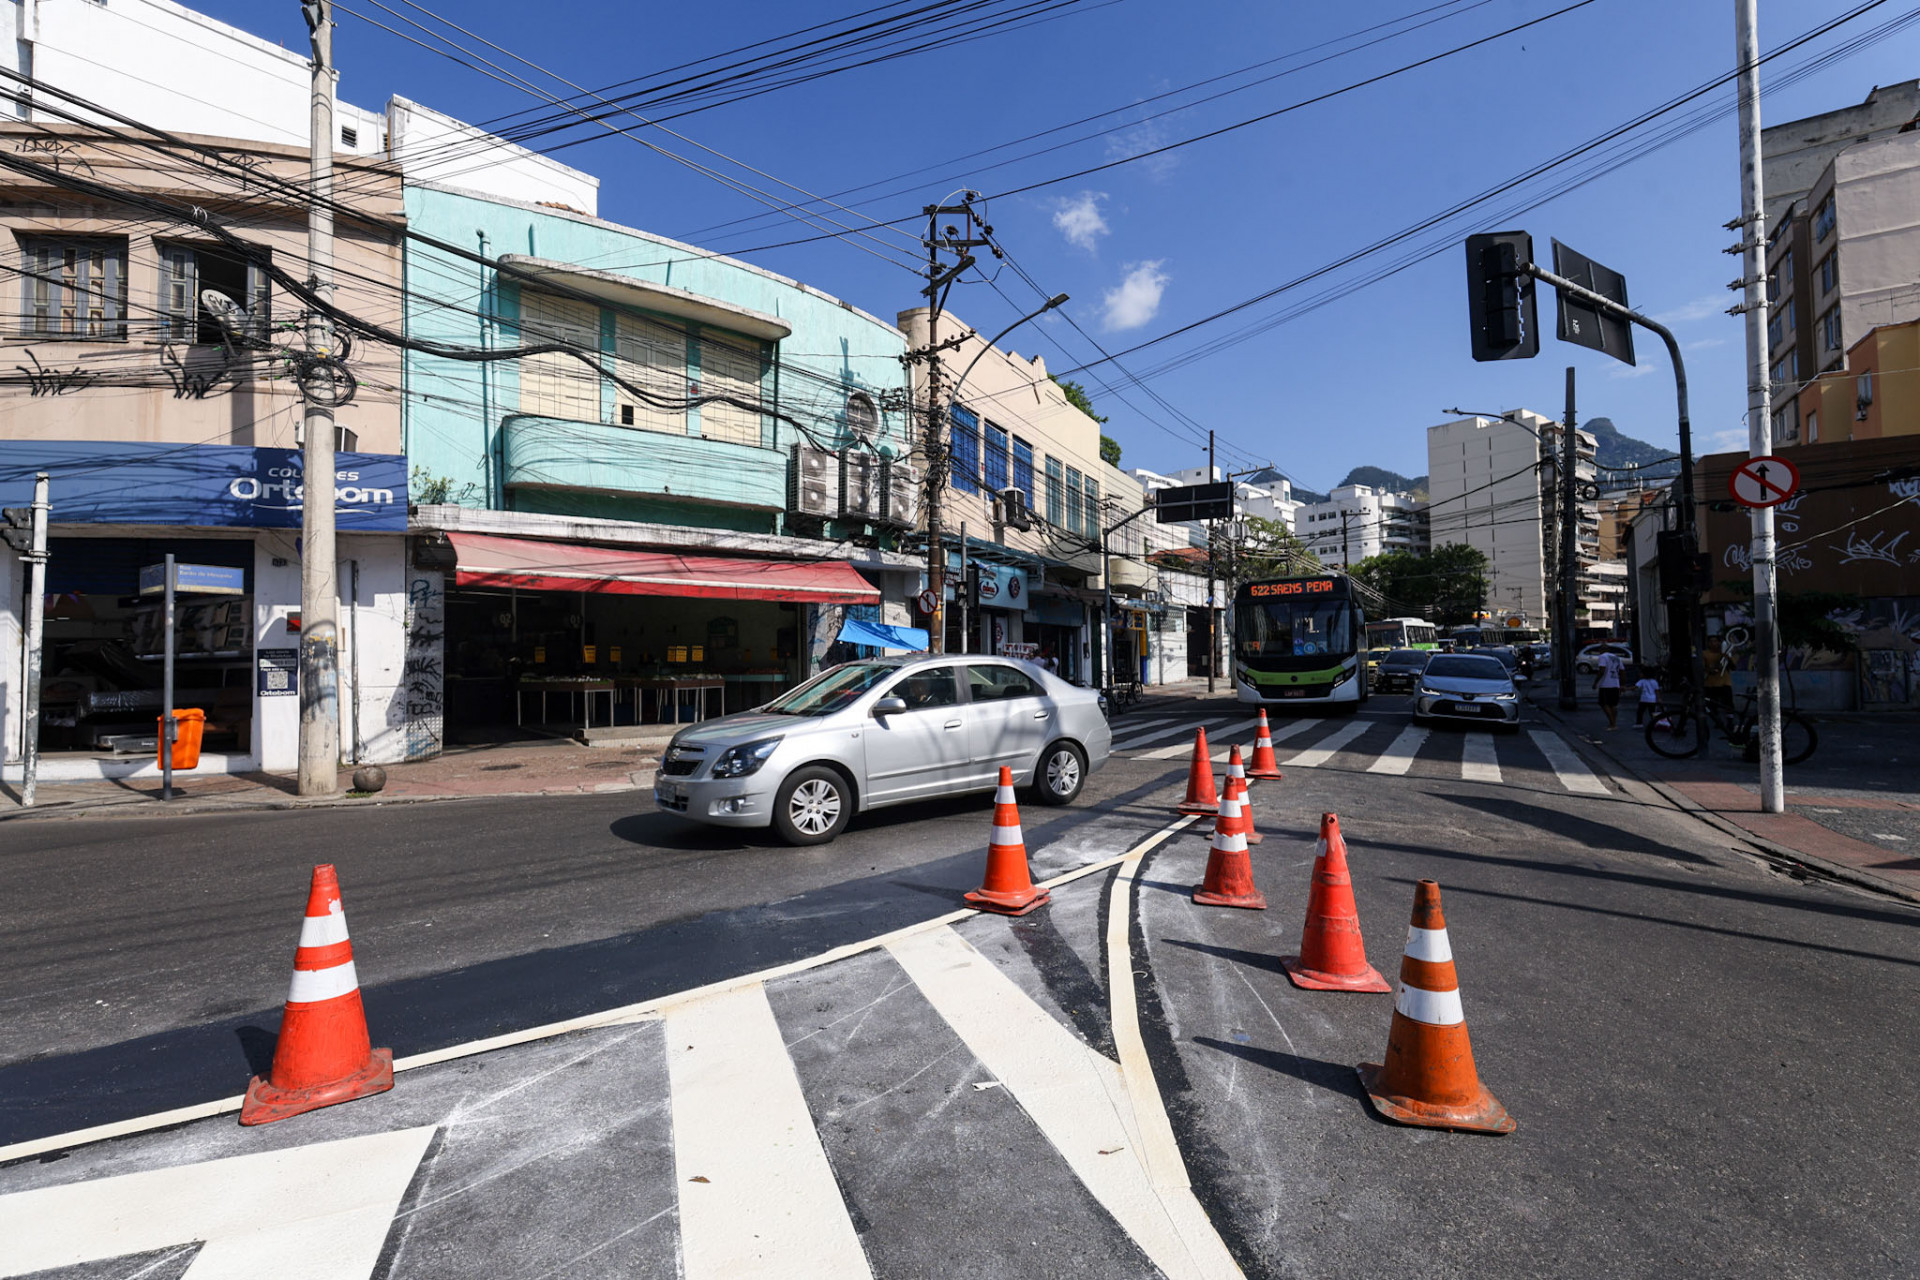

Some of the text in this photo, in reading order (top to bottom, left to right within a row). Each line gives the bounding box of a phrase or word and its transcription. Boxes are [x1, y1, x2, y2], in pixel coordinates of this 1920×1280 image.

[268, 467, 359, 482] COLES
[1251, 580, 1333, 596] 622 SAENS PENA
